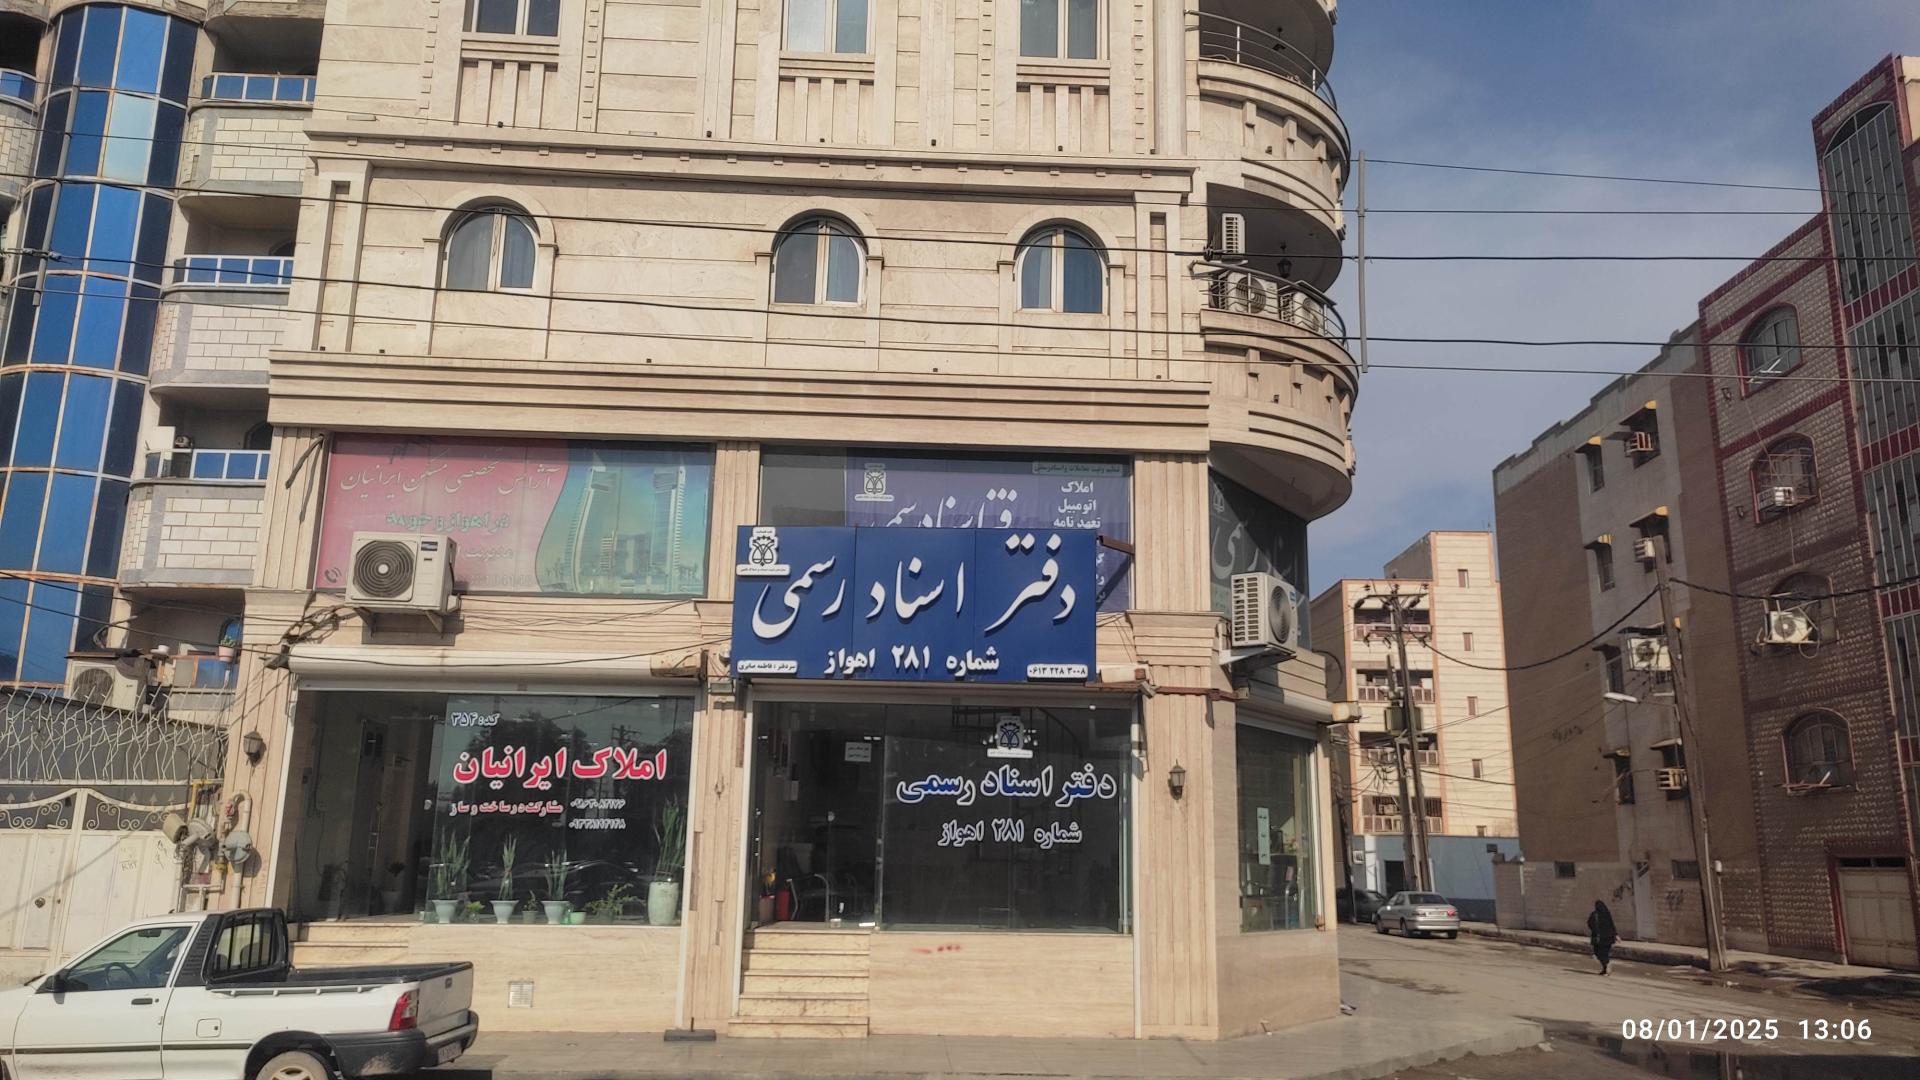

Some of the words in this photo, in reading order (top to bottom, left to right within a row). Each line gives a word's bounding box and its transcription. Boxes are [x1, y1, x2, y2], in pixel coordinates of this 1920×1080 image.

[340, 463, 401, 498] ایرانیان
[1061, 481, 1094, 493] املاک
[1058, 498, 1096, 514] اتومبیل
[1053, 516, 1074, 528] نامه
[1077, 516, 1101, 529] تعهد
[866, 556, 965, 620] اسناد
[984, 533, 1076, 632] دفتر
[751, 555, 847, 640] رسمی
[823, 647, 876, 675] اهواز
[891, 644, 931, 670] ۲۸۱
[945, 645, 1000, 676] شماره
[453, 745, 568, 790] ایرانیان
[572, 747, 668, 780] املاک
[896, 774, 976, 805] رسمی
[980, 763, 1054, 797] اسناد
[1055, 763, 1117, 808] دفتر
[449, 800, 470, 817] ساز
[479, 800, 511, 813] ساخت
[525, 799, 564, 817] مشارکت
[938, 819, 985, 847] اهواز
[991, 818, 1025, 842] ۲۸۱
[1033, 821, 1083, 849] شماره
